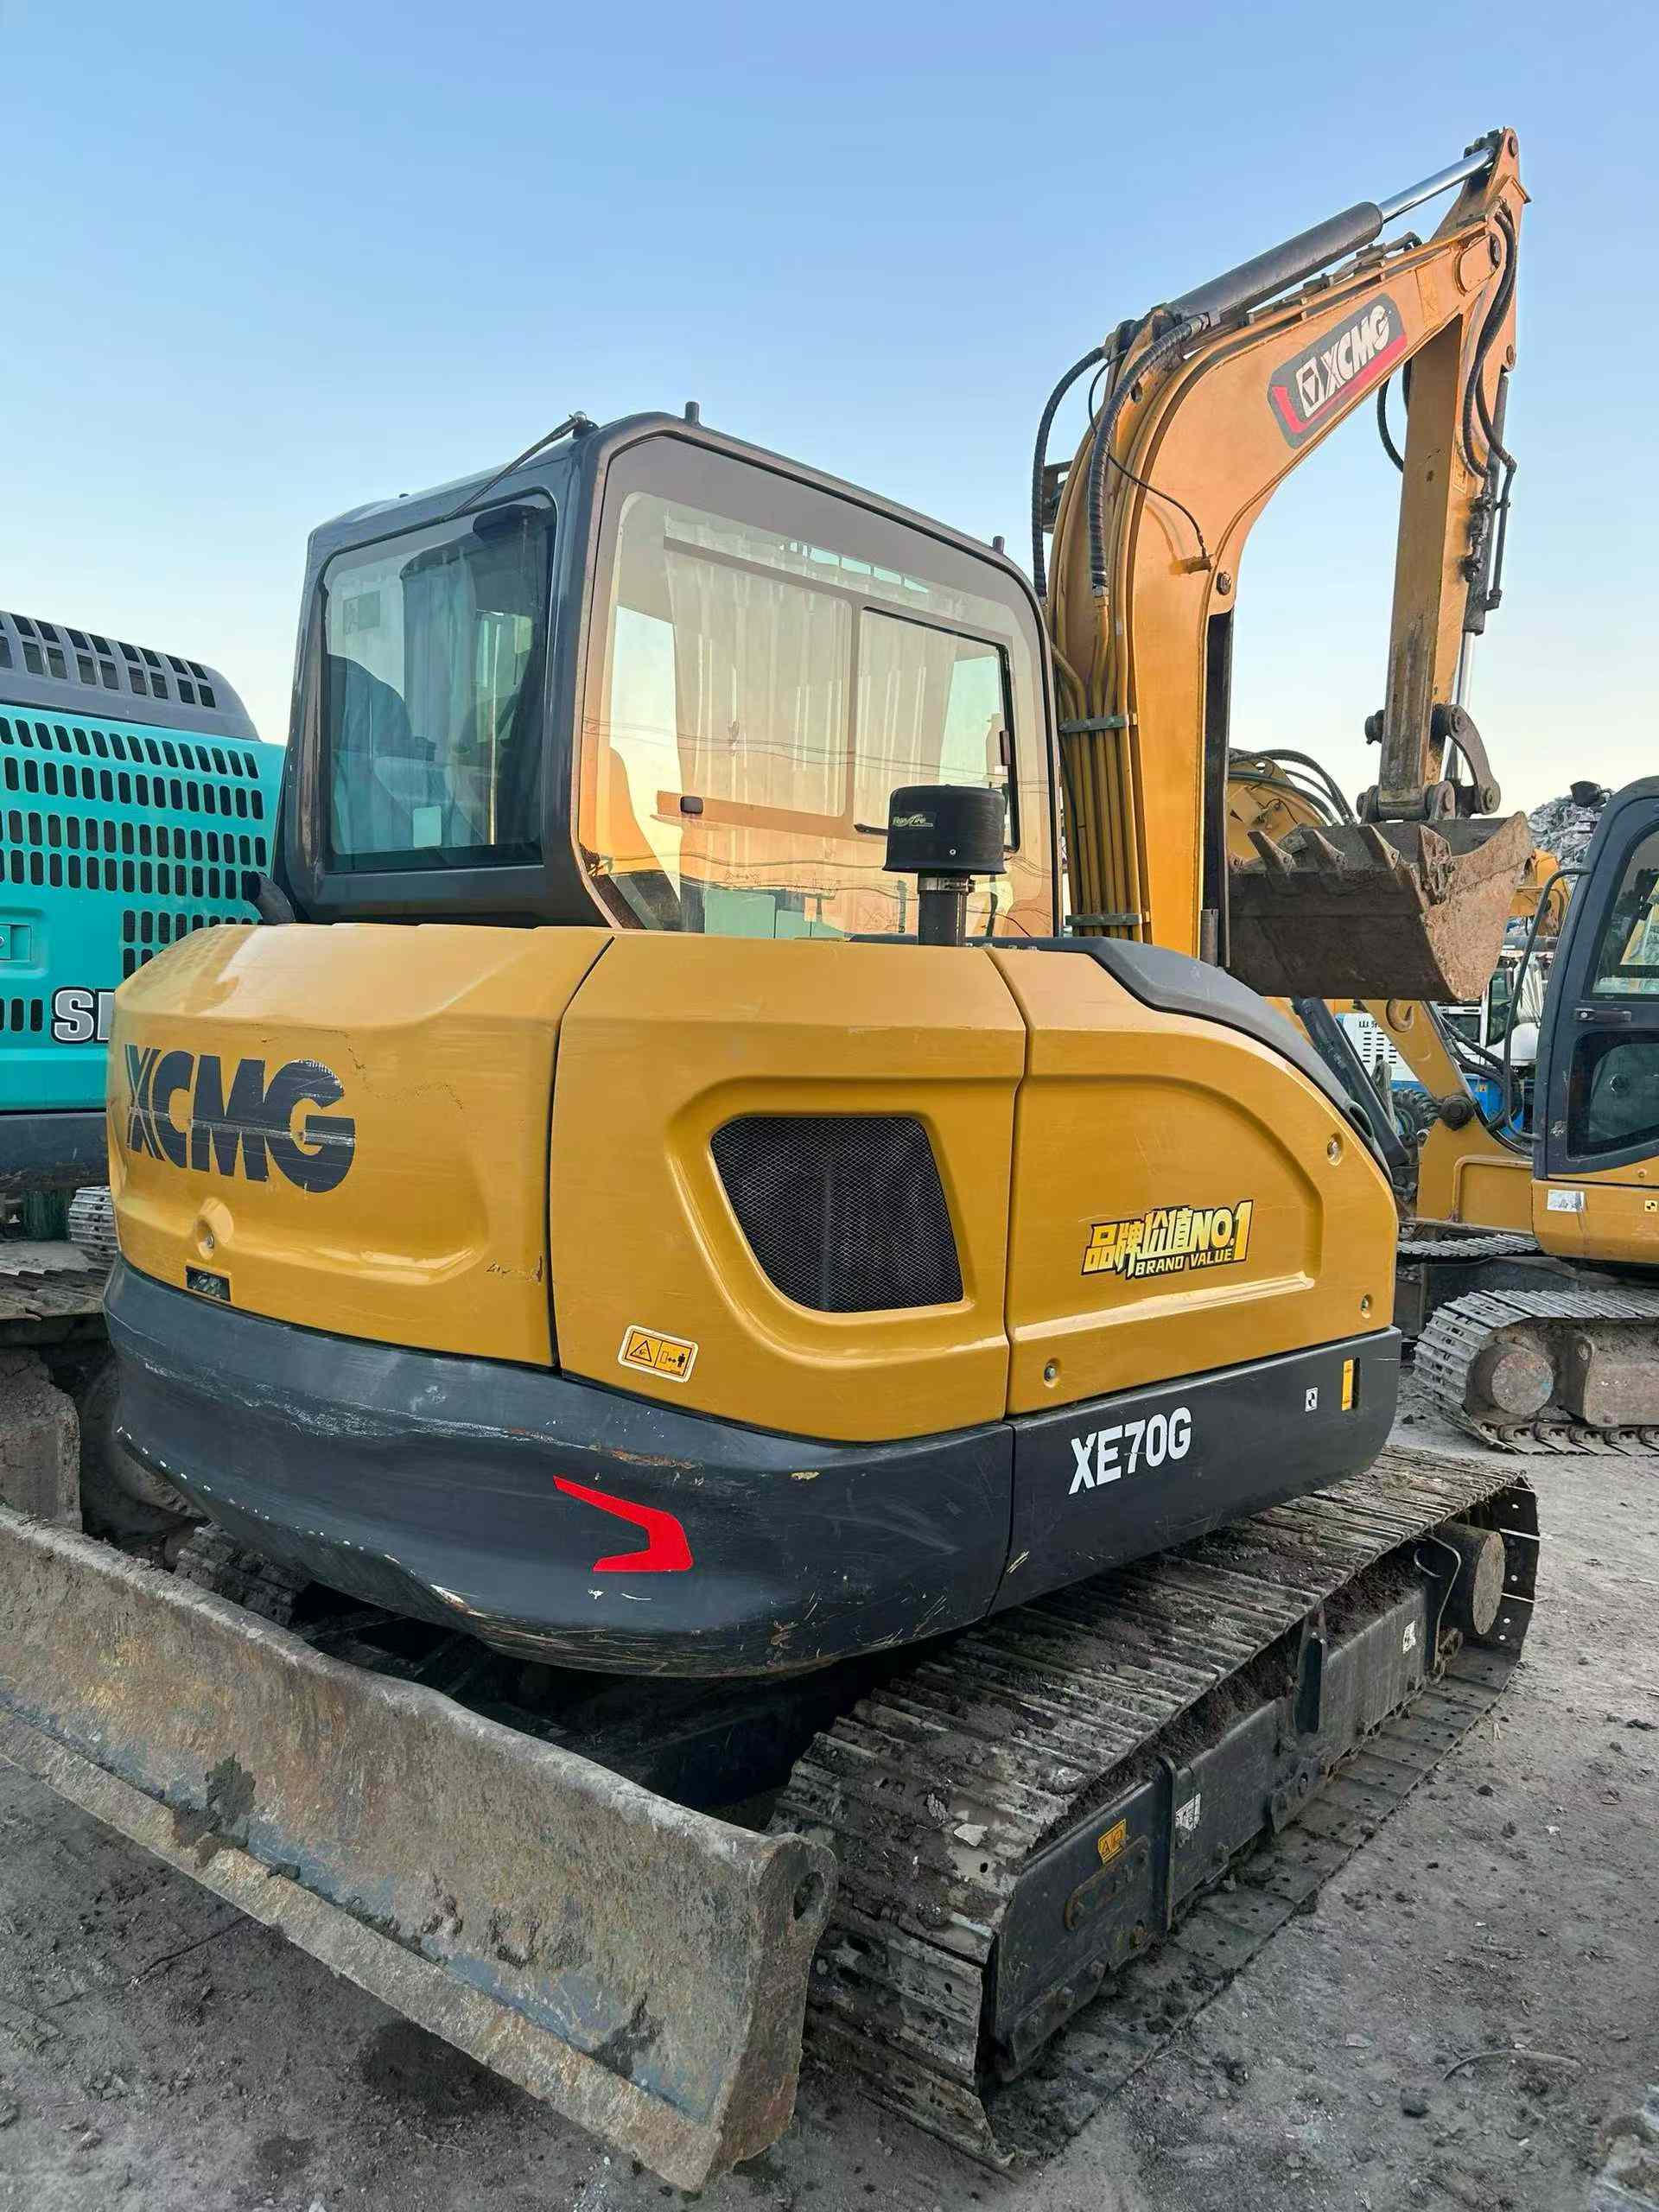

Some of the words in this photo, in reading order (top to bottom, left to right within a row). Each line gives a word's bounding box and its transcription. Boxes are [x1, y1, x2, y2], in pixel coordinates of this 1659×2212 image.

[1320, 305, 1389, 400] XCMG
[125, 1043, 355, 1193] XCMG
[1135, 1255, 1184, 1276] BRAND
[1190, 1248, 1233, 1268] VALUE
[1068, 1406, 1192, 1496] XE70G
